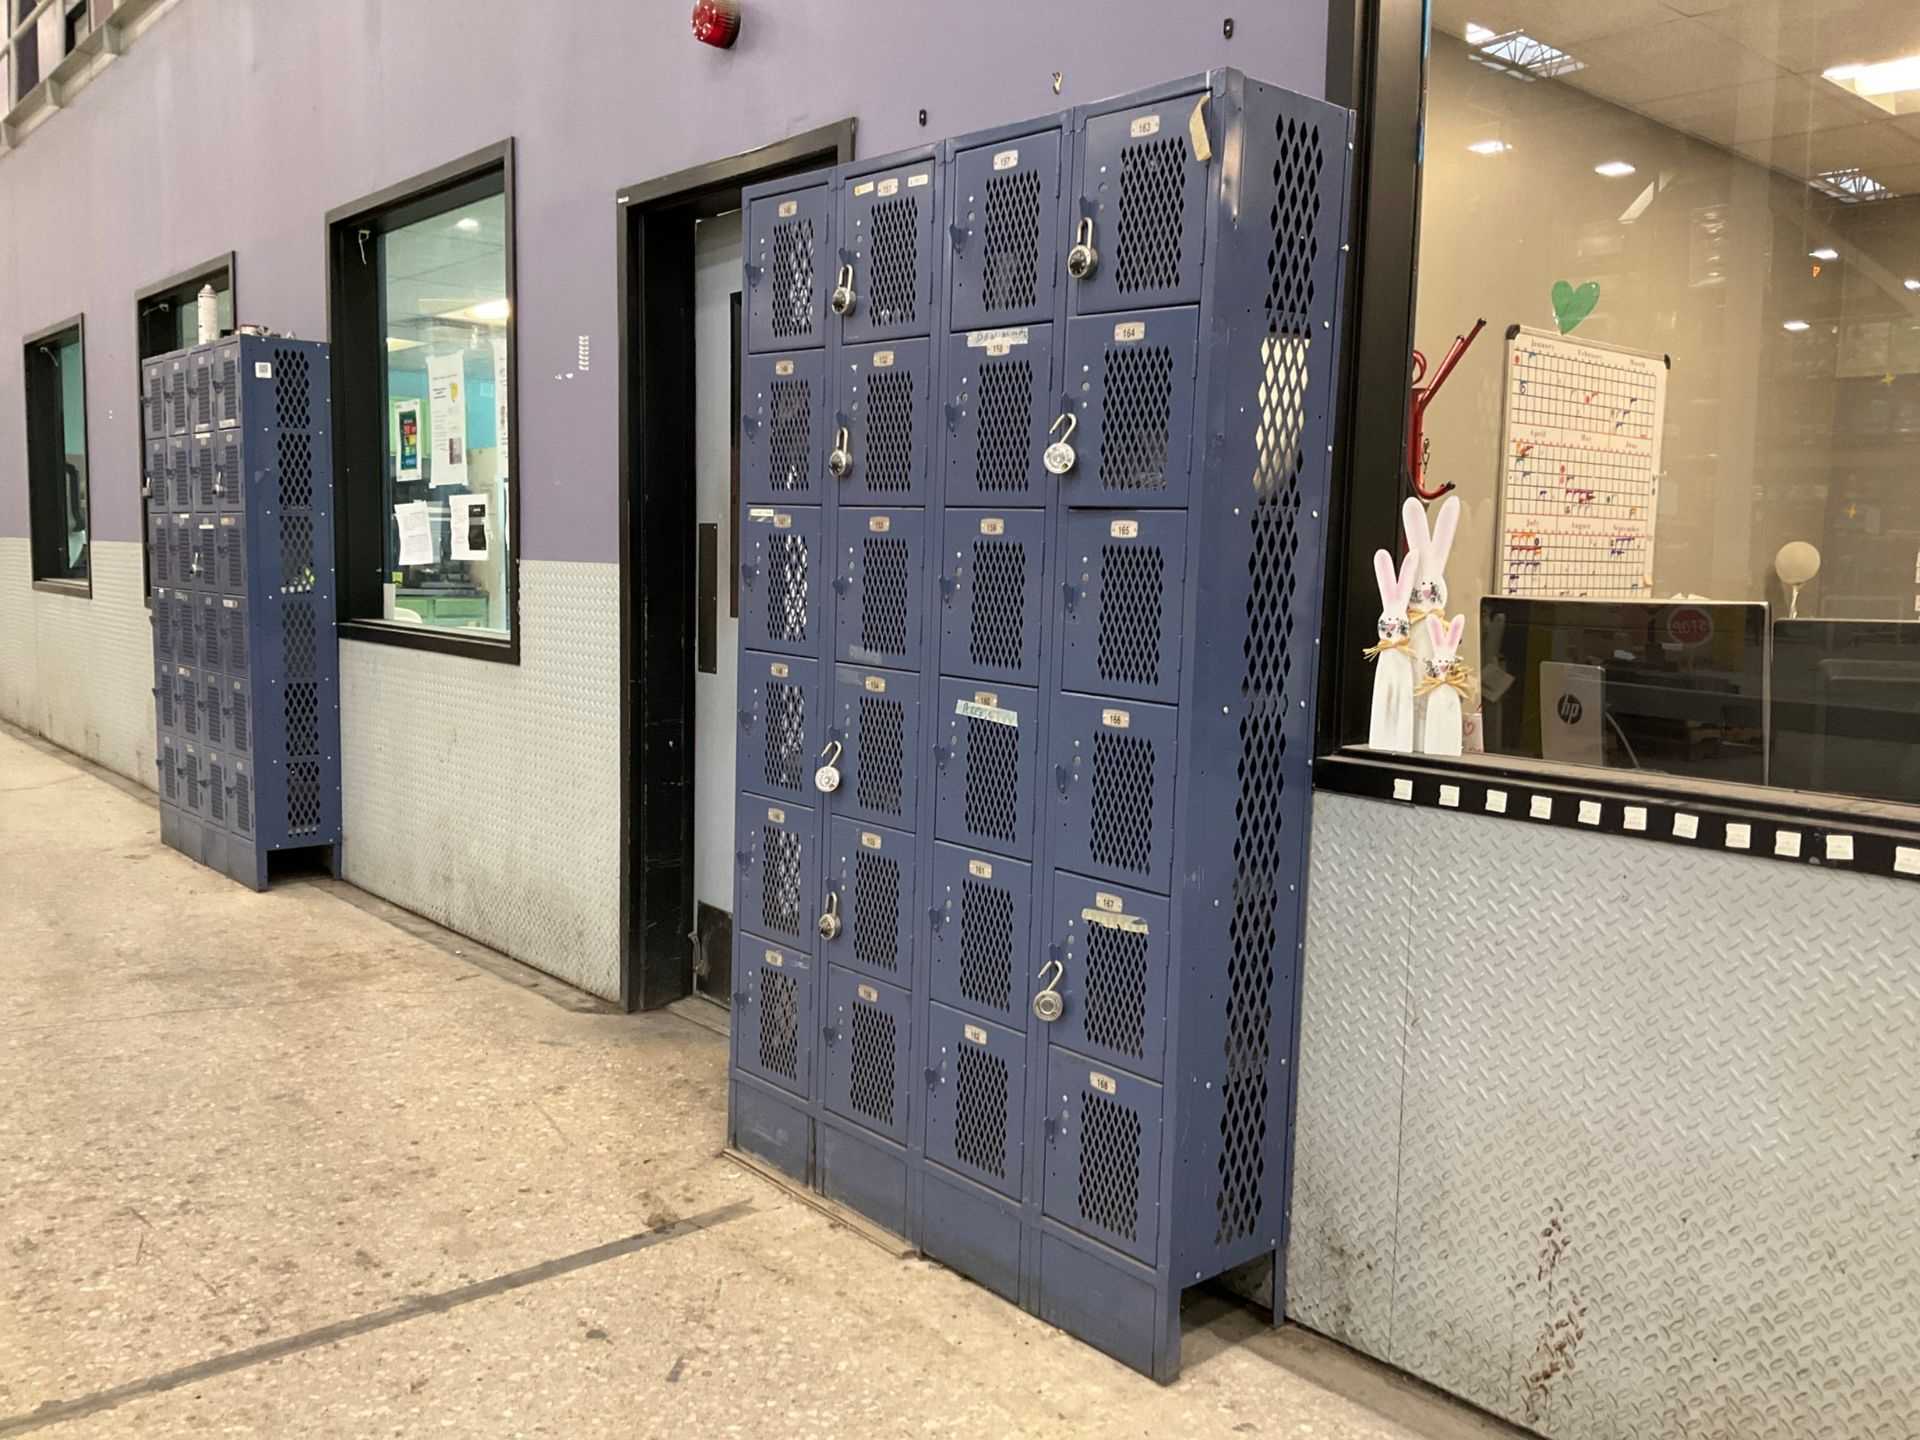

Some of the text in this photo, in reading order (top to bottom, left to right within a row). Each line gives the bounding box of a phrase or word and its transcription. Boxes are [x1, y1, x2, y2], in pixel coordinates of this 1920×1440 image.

[1123, 327, 1135, 338] 164
[1118, 525, 1130, 535] 165
[1559, 693, 1580, 724] hp
[1110, 714, 1121, 725] 166
